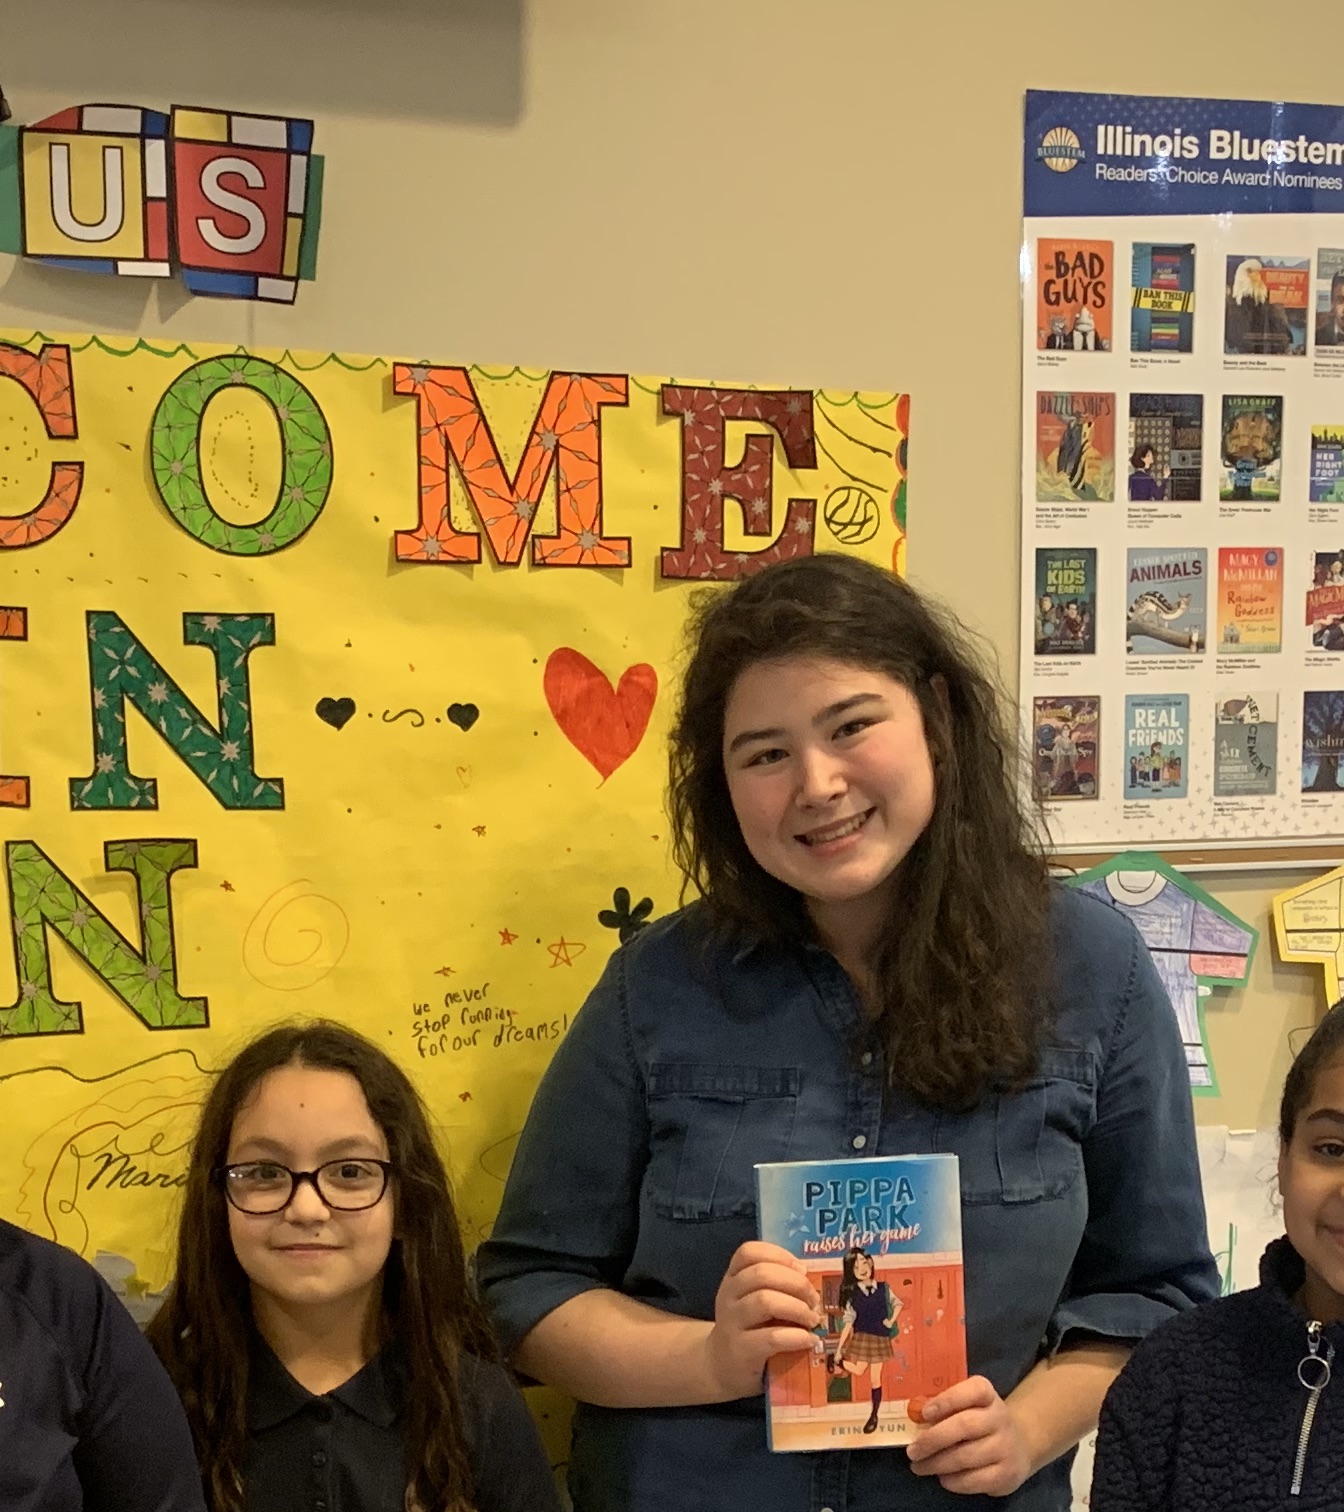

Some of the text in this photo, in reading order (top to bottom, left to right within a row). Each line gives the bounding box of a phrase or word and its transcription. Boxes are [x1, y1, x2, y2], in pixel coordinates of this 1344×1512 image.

[1096, 123, 1200, 159] Illinois
[1037, 146, 1086, 159] BLUESTEM
[1166, 165, 1219, 184] Choice
[1221, 167, 1270, 187] Award
[1272, 172, 1343, 190] Nominees
[51, 143, 268, 254] US
[1055, 251, 1105, 280] BAD
[1043, 277, 1107, 309] GUYS
[1143, 288, 1183, 302] BAN THIS
[1151, 299, 1174, 310] BOOK
[1315, 453, 1335, 461] HER
[1315, 461, 1343, 470] RIGHT
[1314, 469, 1340, 478] FOOT
[1063, 559, 1086, 570] LAST
[1129, 559, 1203, 583] ANIMALS
[1047, 570, 1086, 585] KIDS
[1058, 583, 1086, 595] EARTH
[1227, 590, 1267, 605] Rainbow
[1234, 604, 1275, 618] Goddess
[1134, 708, 1180, 728] REAL
[1245, 694, 1260, 722] WET
[1246, 724, 1273, 777] CEMENT
[444, 983, 490, 1008] never
[803, 1176, 916, 1210] PIPPA
[816, 1203, 911, 1237] PARK
[803, 1222, 922, 1257] raises her game
[831, 1424, 906, 1436] ERIN YUN
